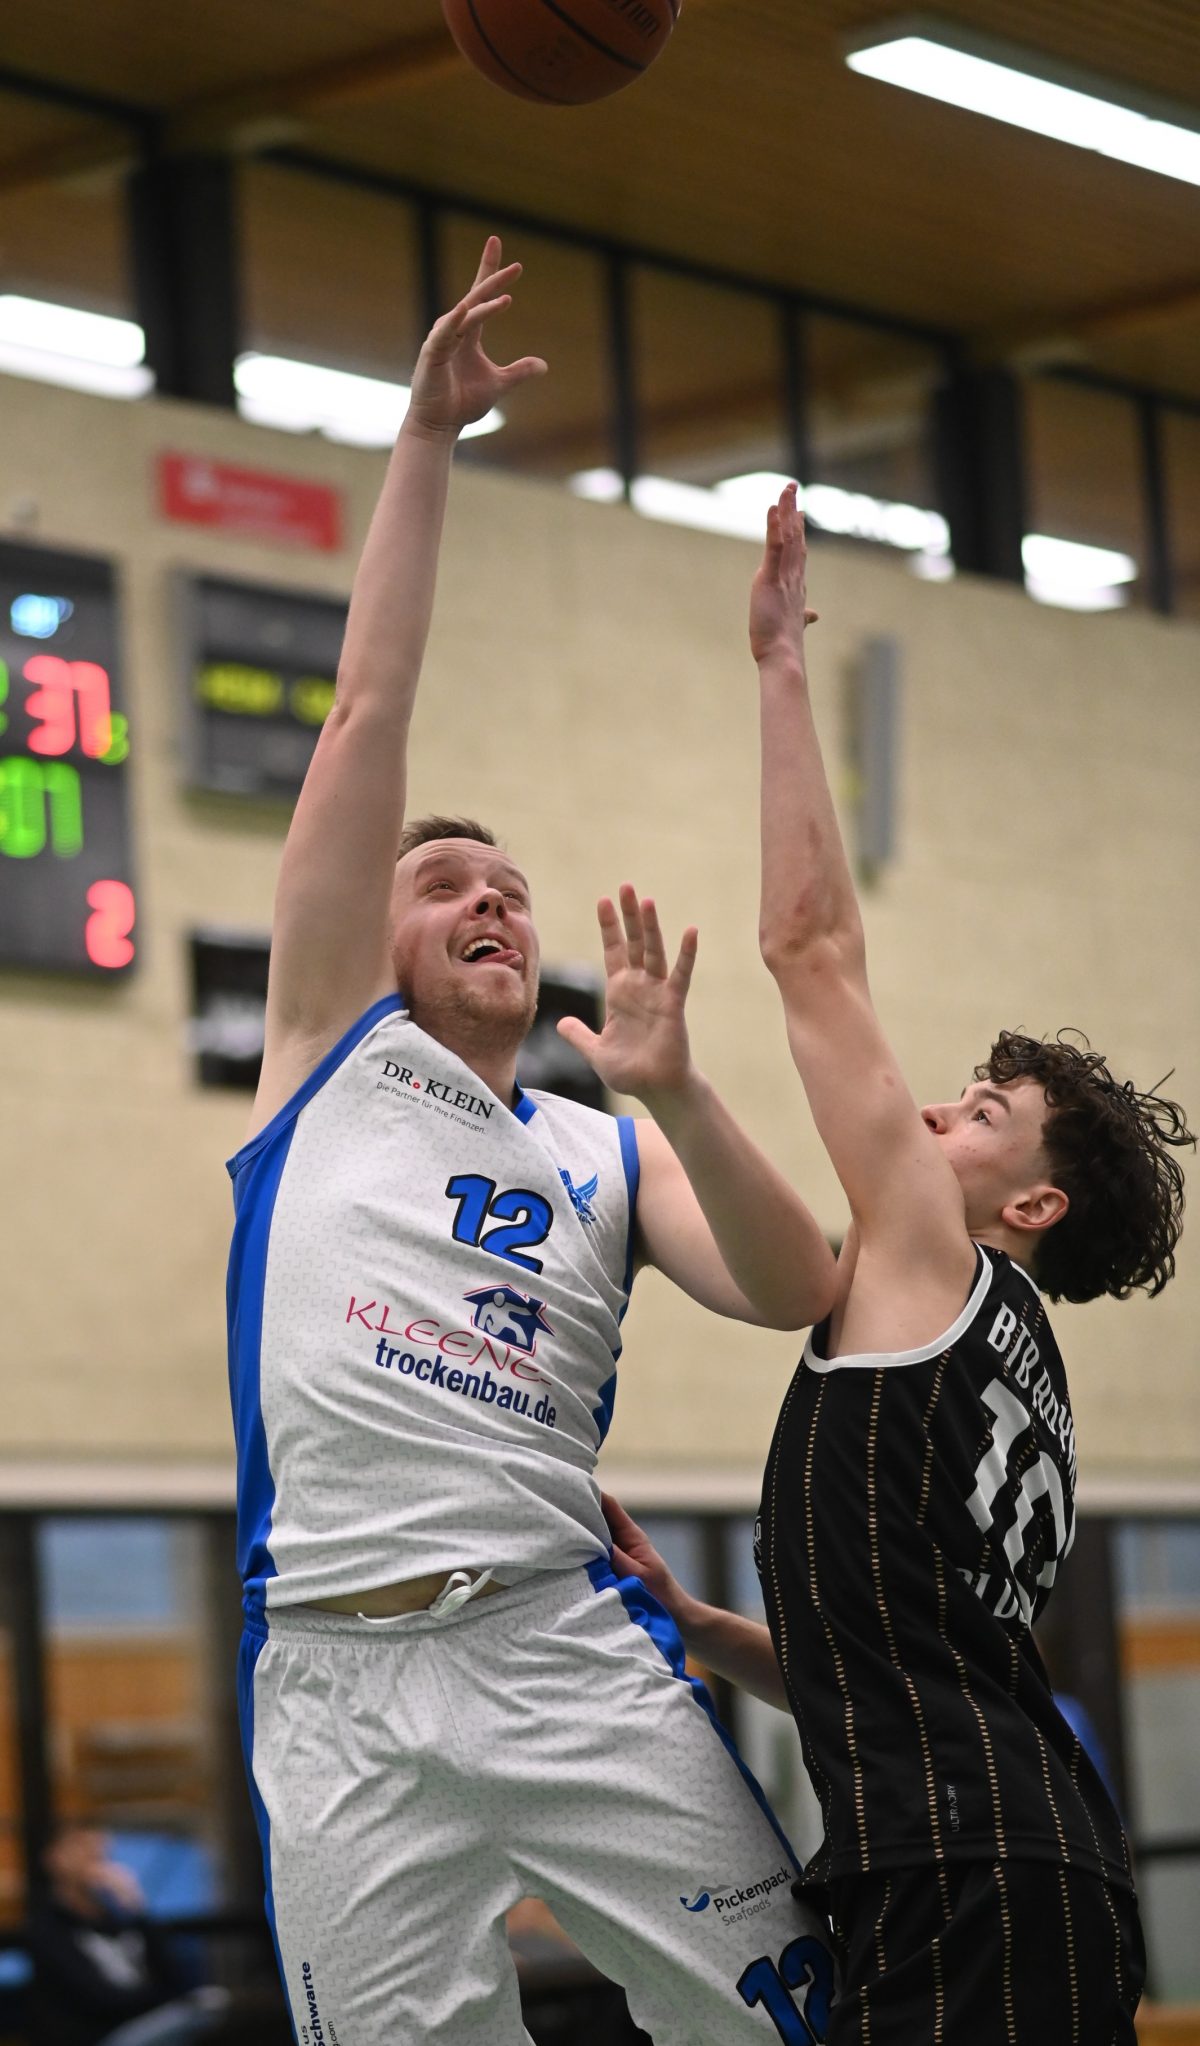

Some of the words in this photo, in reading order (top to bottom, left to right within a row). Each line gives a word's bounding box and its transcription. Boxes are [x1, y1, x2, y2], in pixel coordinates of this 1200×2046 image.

[376, 1081, 390, 1093] Die
[391, 1087, 421, 1104] Partner
[422, 1099, 432, 1110] für
[434, 1105, 449, 1118] Ihre
[449, 1113, 487, 1135] Finanzen.
[424, 1078, 495, 1119] KLEIN
[445, 1173, 554, 1275] 12
[987, 1301, 1039, 1389] BTB
[374, 1337, 556, 1428] trockenbau.de
[946, 1784, 960, 1833] ULTRADRY
[713, 1867, 792, 1913] Pickenpack
[721, 1898, 772, 1927] Seafoods
[736, 1935, 835, 2046] 12
